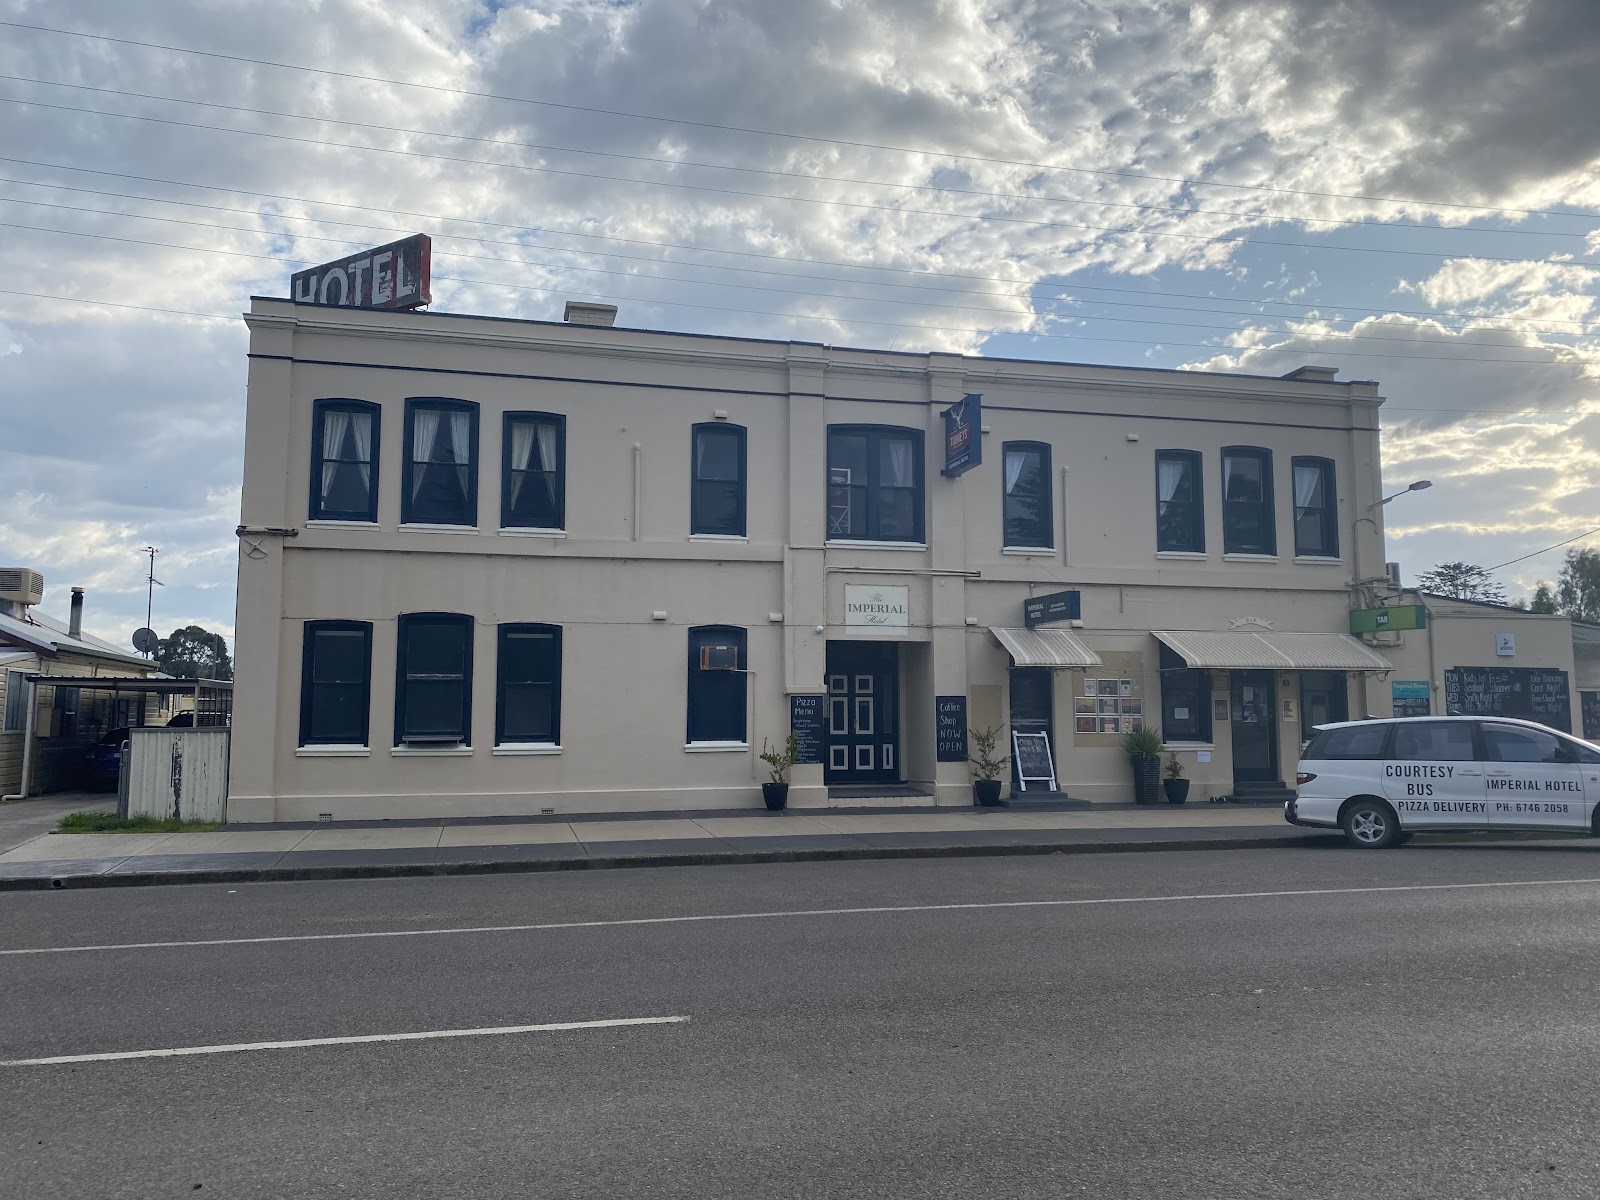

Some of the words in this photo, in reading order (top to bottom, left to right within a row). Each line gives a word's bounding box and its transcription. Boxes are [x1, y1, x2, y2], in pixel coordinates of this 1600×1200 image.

[870, 594, 883, 602] The
[848, 604, 906, 614] IMPERIAL
[864, 615, 889, 624] Hotel
[1376, 616, 1388, 624] TAB
[1447, 682, 1460, 692] TUES
[796, 697, 816, 706] Pizza
[794, 707, 814, 715] Menu
[940, 703, 960, 712] Coffee
[940, 715, 957, 727] Shop
[940, 729, 961, 739] NOW
[940, 742, 963, 751] OPEN
[1386, 765, 1454, 778] COURTESY
[1407, 783, 1433, 795] BUS
[1487, 780, 1540, 790] IMPERIAL
[1545, 781, 1581, 792] HOTEL
[1398, 802, 1430, 811] PIZZA
[1433, 802, 1486, 812] DELIVERY
[1496, 803, 1512, 812] PH:
[1516, 803, 1540, 812] 6746
[1544, 804, 1568, 813] 2058
